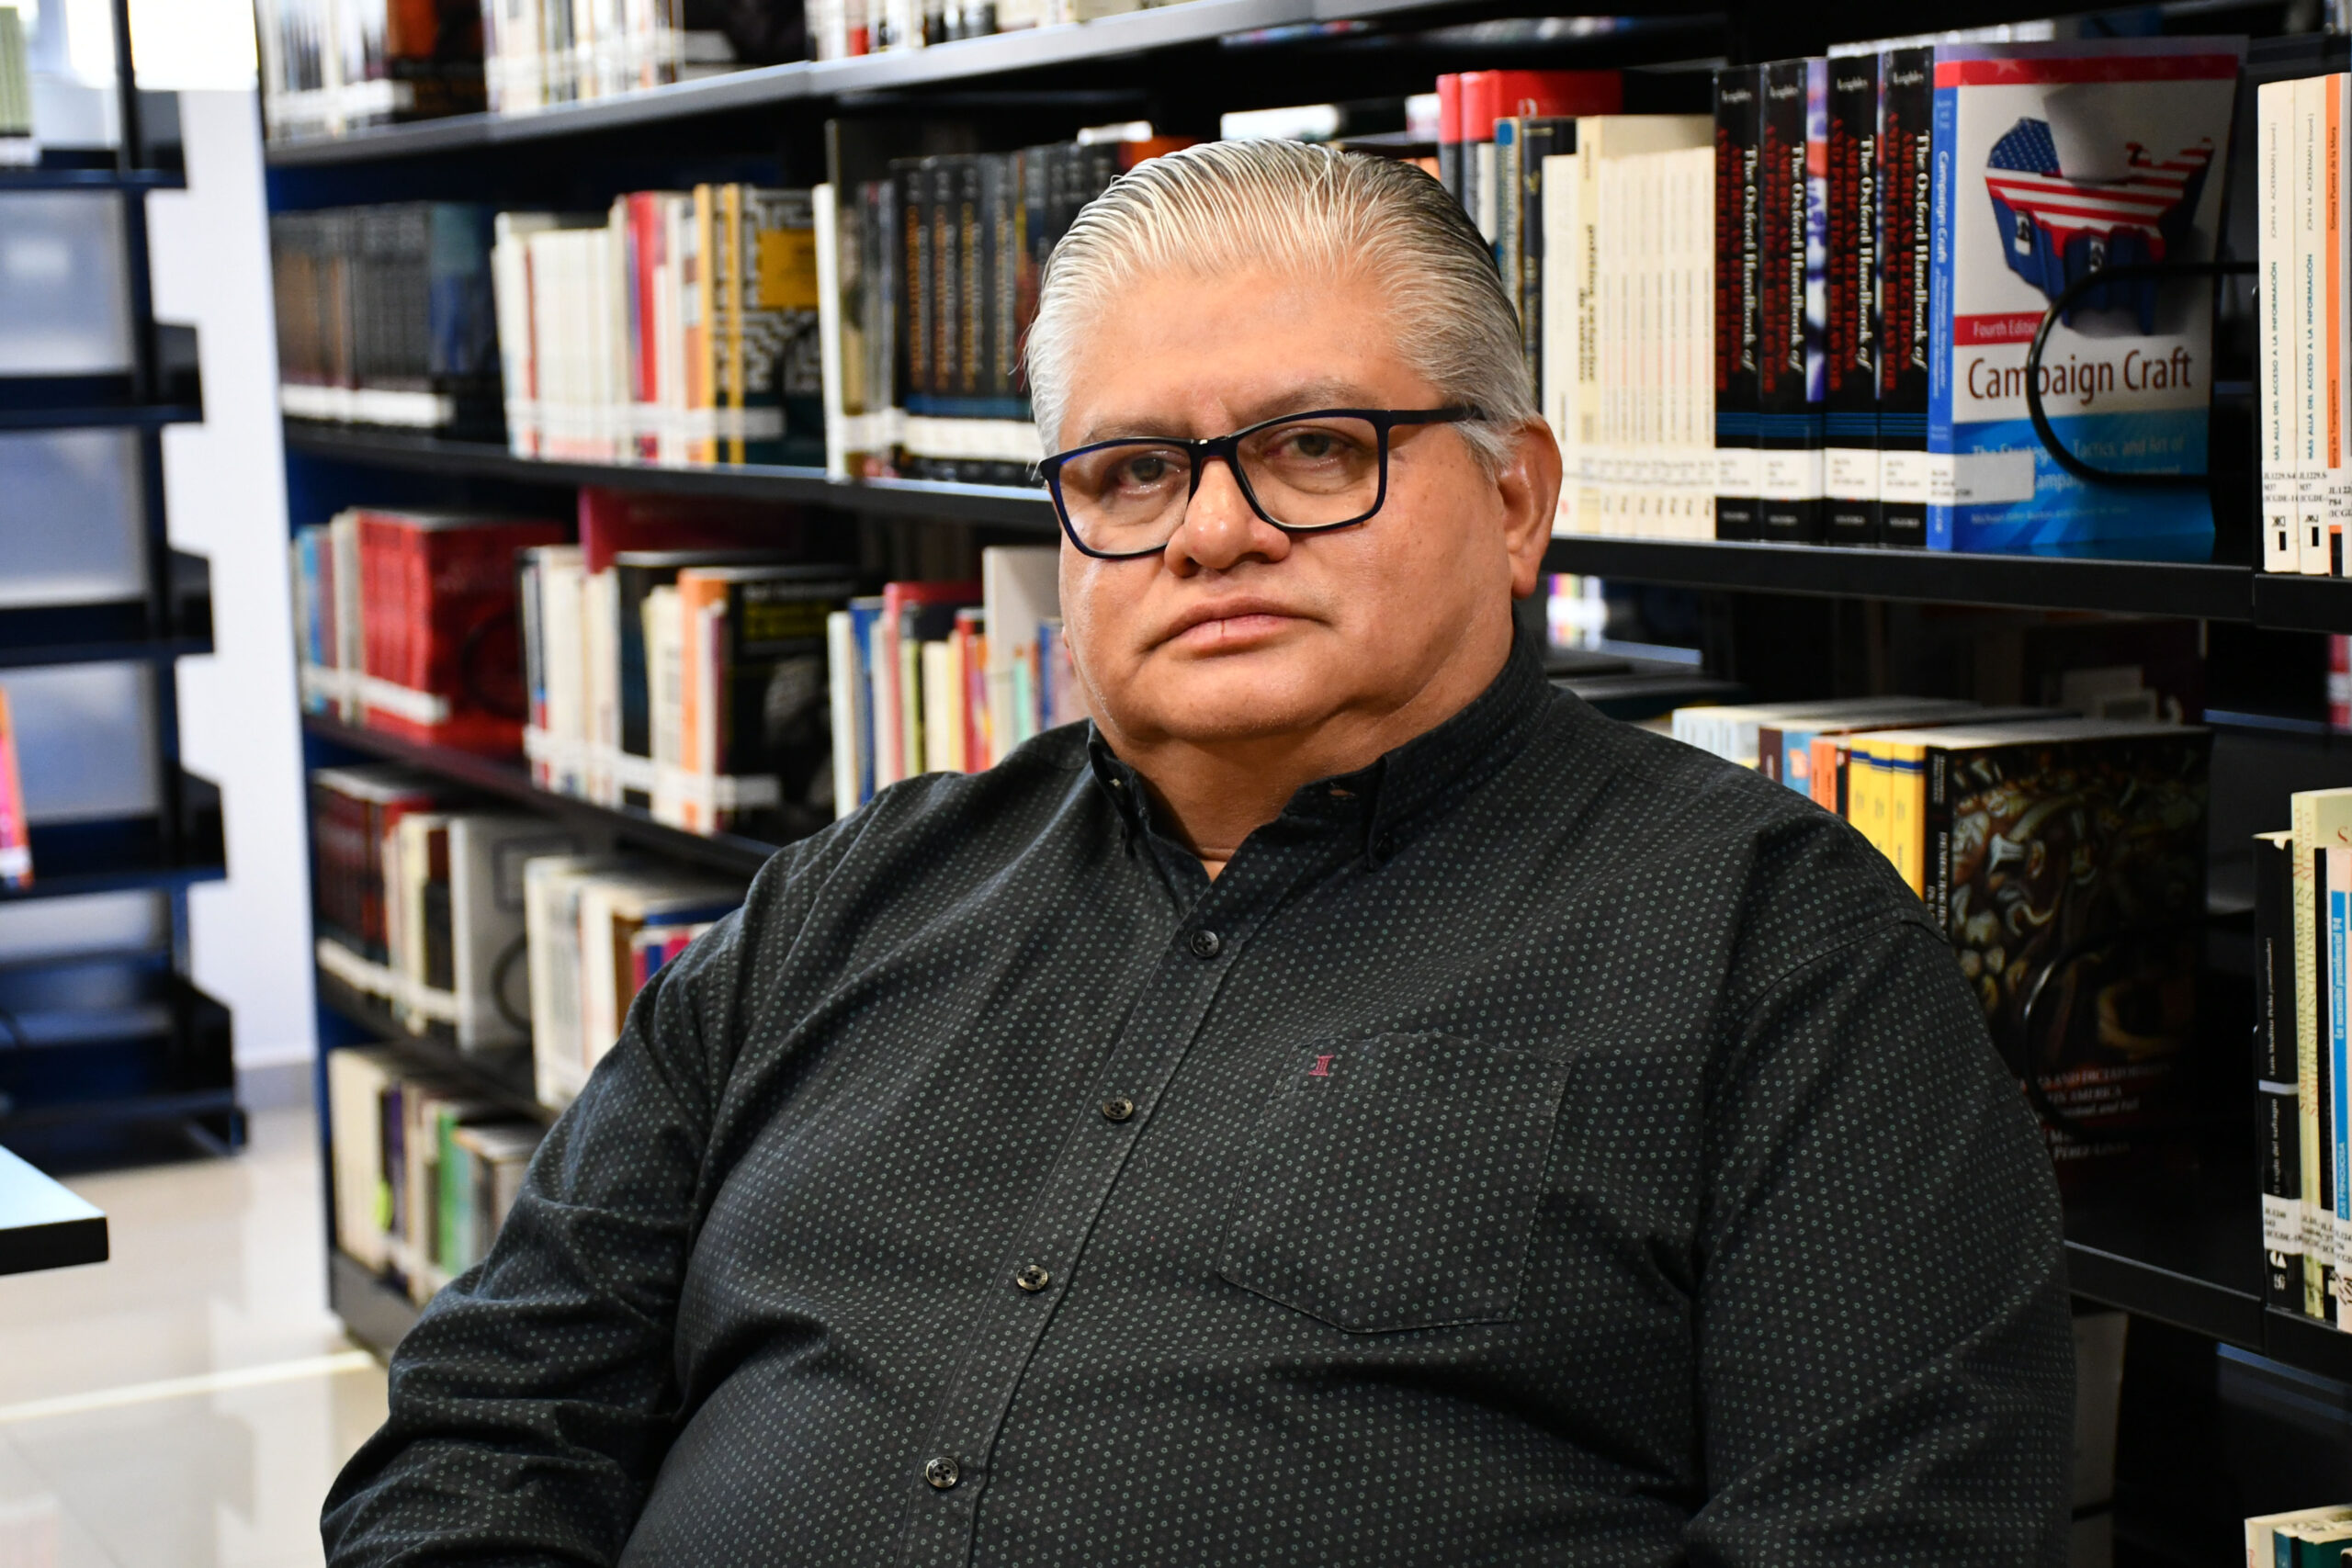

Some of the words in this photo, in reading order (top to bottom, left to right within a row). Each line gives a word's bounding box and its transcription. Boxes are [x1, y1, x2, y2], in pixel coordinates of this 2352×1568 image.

[1745, 145, 1758, 182] The
[1792, 141, 1804, 180] The
[1860, 135, 1874, 175] The
[1917, 130, 1930, 169] The
[2330, 150, 2336, 158] la
[2330, 160, 2336, 169] de
[1902, 130, 1914, 245] AMERICAN
[1916, 172, 1929, 240] Oxford
[1936, 151, 1950, 226] Campaign
[2307, 197, 2313, 205] M.
[1744, 186, 1758, 249] Oxford
[1791, 183, 1804, 249] Oxford
[1860, 176, 1874, 243] Oxford
[2270, 204, 2277, 213] M.
[1936, 227, 1949, 264] Craft
[1743, 254, 1757, 345] Handbook
[1791, 253, 1804, 346] Handbook
[1859, 247, 1873, 344] Handbook
[1915, 245, 1929, 343] Handbook
[2305, 254, 2313, 324] INFORMACIÓN
[1900, 251, 1913, 371] ELECTIONS
[1973, 318, 2007, 339] Fourth
[2271, 334, 2278, 346] LA
[2306, 328, 2313, 340] LA
[1741, 350, 1757, 374] of
[1788, 350, 1804, 375] of
[1856, 346, 1873, 373] of
[1911, 346, 1928, 372] of
[2123, 345, 2193, 391] Craft
[2330, 379, 2338, 434] Transparencia
[2123, 437, 2146, 457] and
[2295, 886, 2304, 907] EN
[2305, 890, 2314, 911] EN
[2332, 917, 2343, 931] 94
[2333, 933, 2345, 987] presidencial
[2295, 913, 2308, 1113] SEMIPRESIDENCIALISMO
[2305, 917, 2318, 1117] SEMIPRESIDENCIALISMO
[2334, 988, 2344, 1026] sucesión
[2335, 1029, 2344, 1040] La
